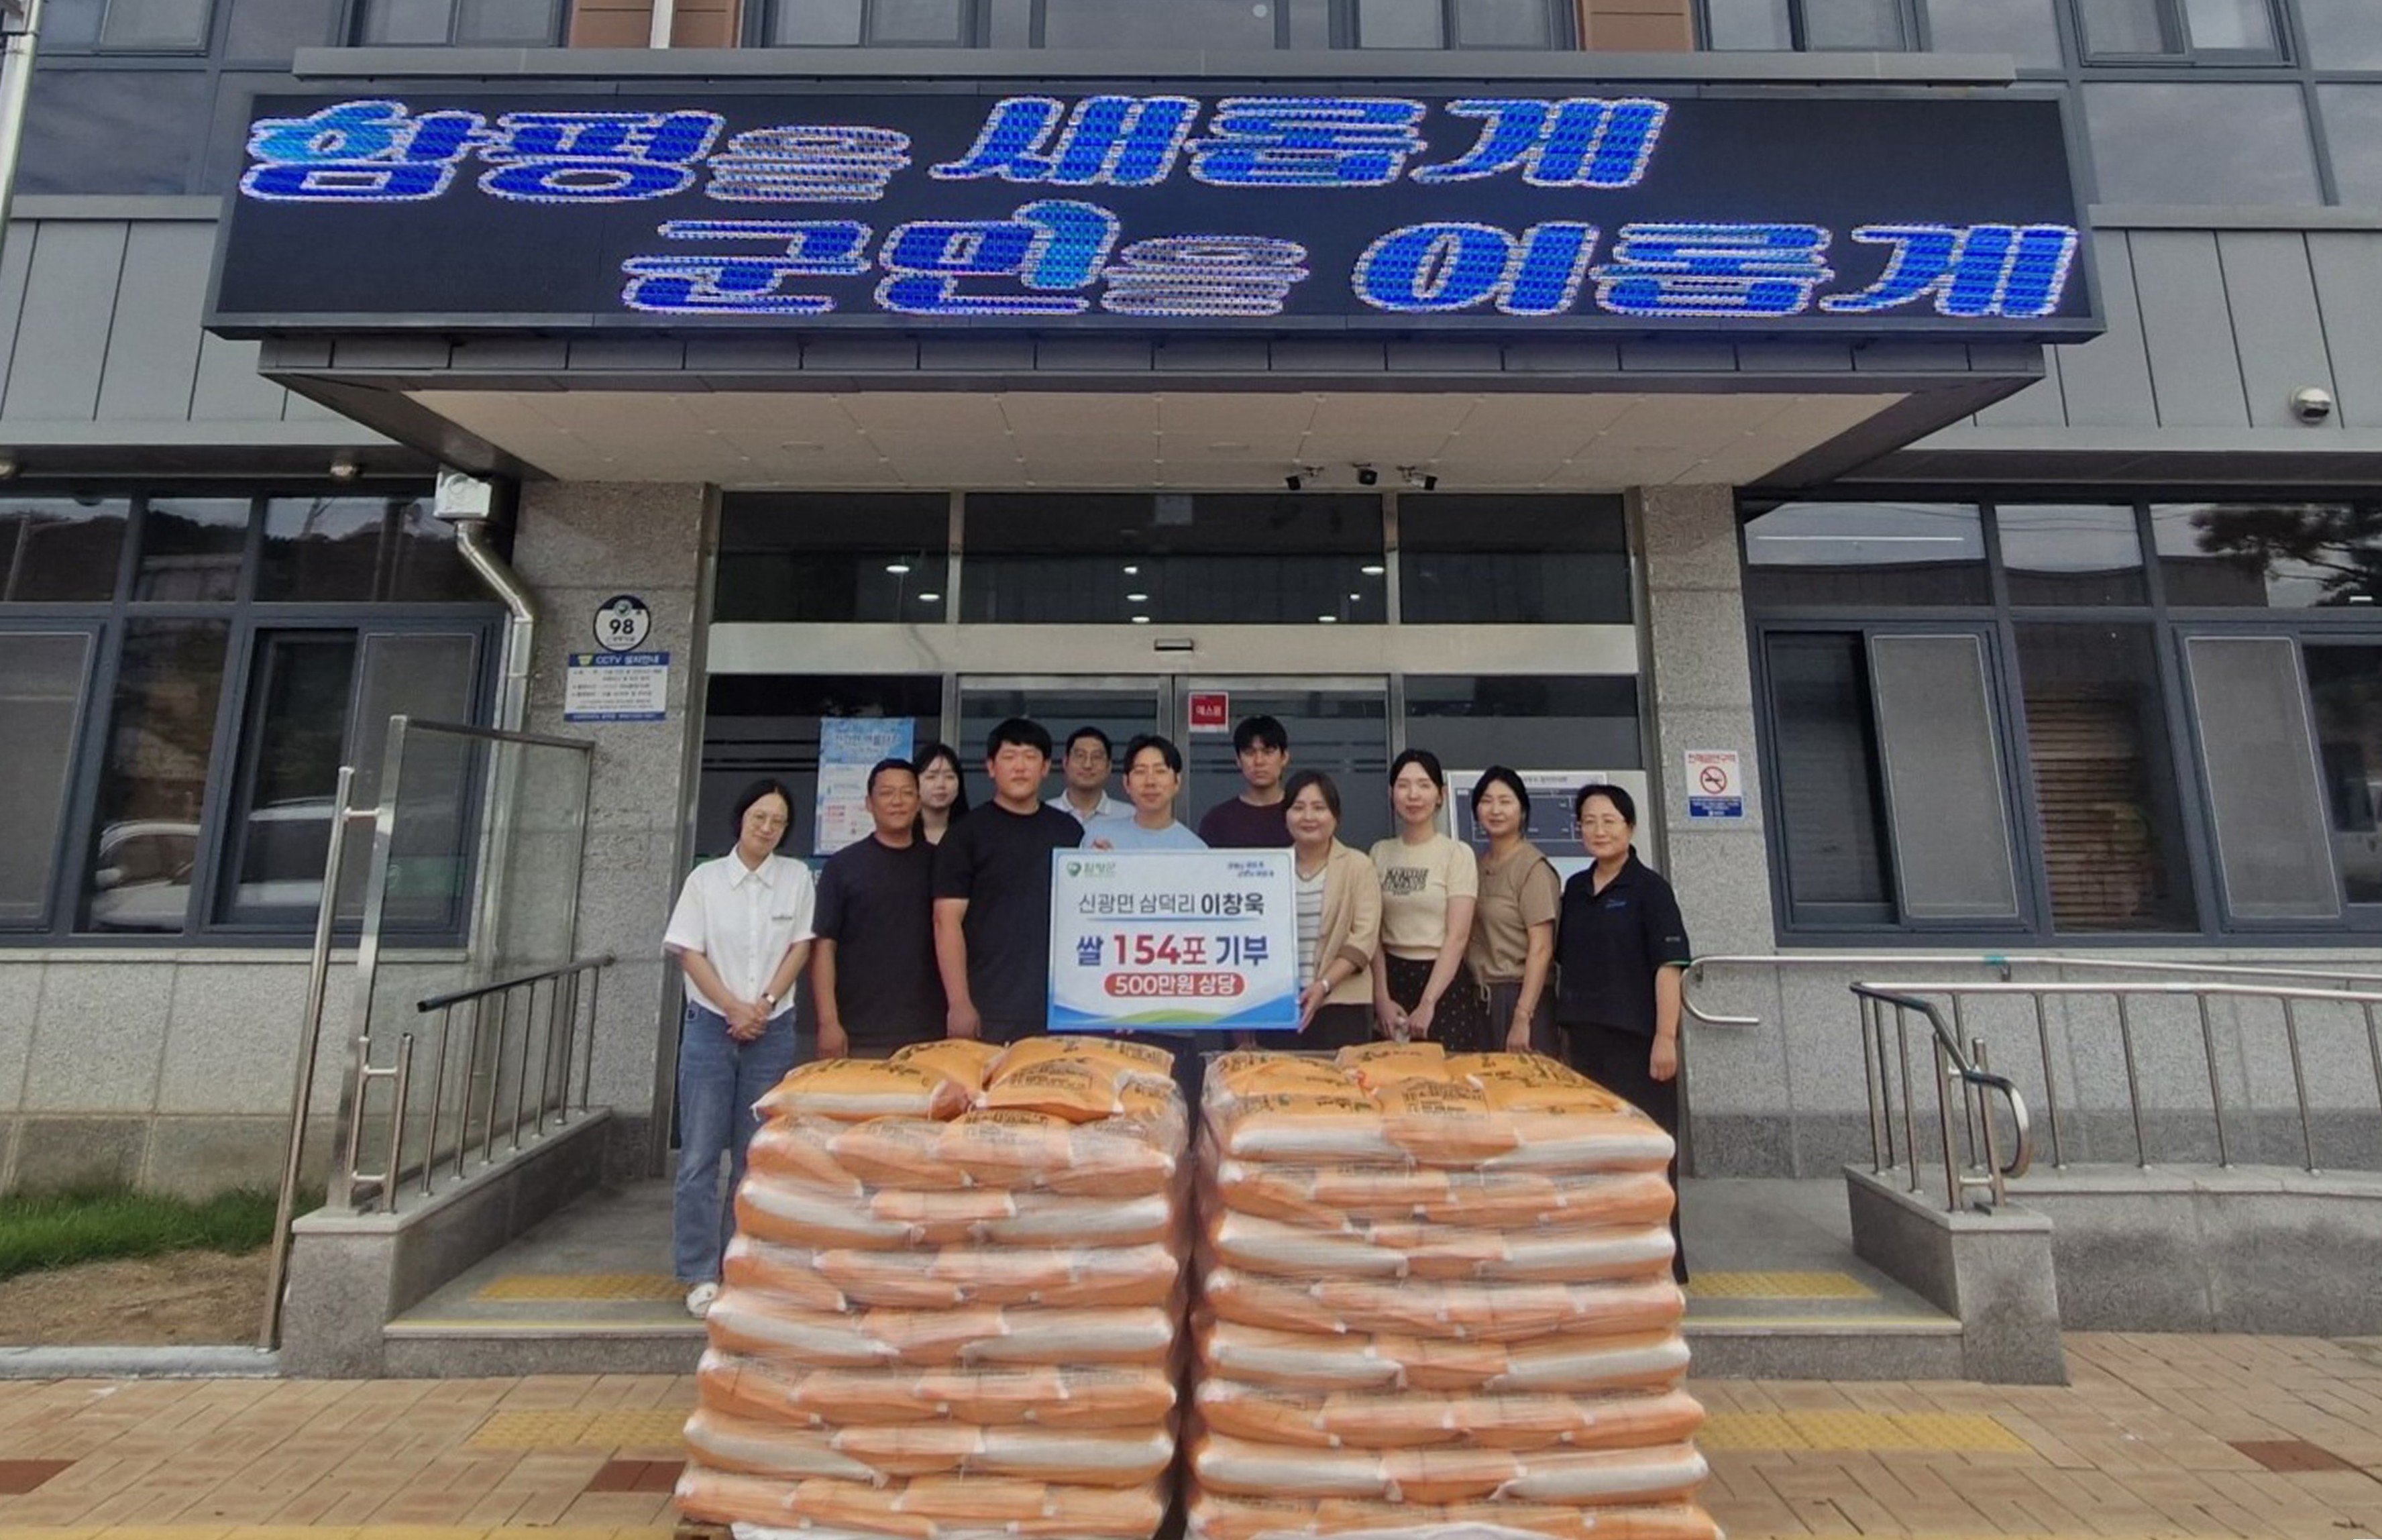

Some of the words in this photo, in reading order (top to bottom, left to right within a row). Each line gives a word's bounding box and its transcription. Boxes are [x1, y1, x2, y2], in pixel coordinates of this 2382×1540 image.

[239, 99, 912, 202] 함평을
[928, 95, 1670, 188] 새롭게
[621, 199, 1309, 317] 군민을
[1350, 219, 2080, 319] 이롭게
[609, 618, 634, 635] 98
[596, 656, 622, 665] CCTV
[1079, 893, 1134, 914] 신광면
[1140, 893, 1195, 914] 삼덕리
[1201, 893, 1264, 915] 이창욱
[1076, 936, 1103, 967] 쌀
[1114, 934, 1206, 966] 154포
[1215, 935, 1268, 966] 기부
[1115, 975, 1193, 995] 500만원
[1198, 975, 1236, 995] 상당
